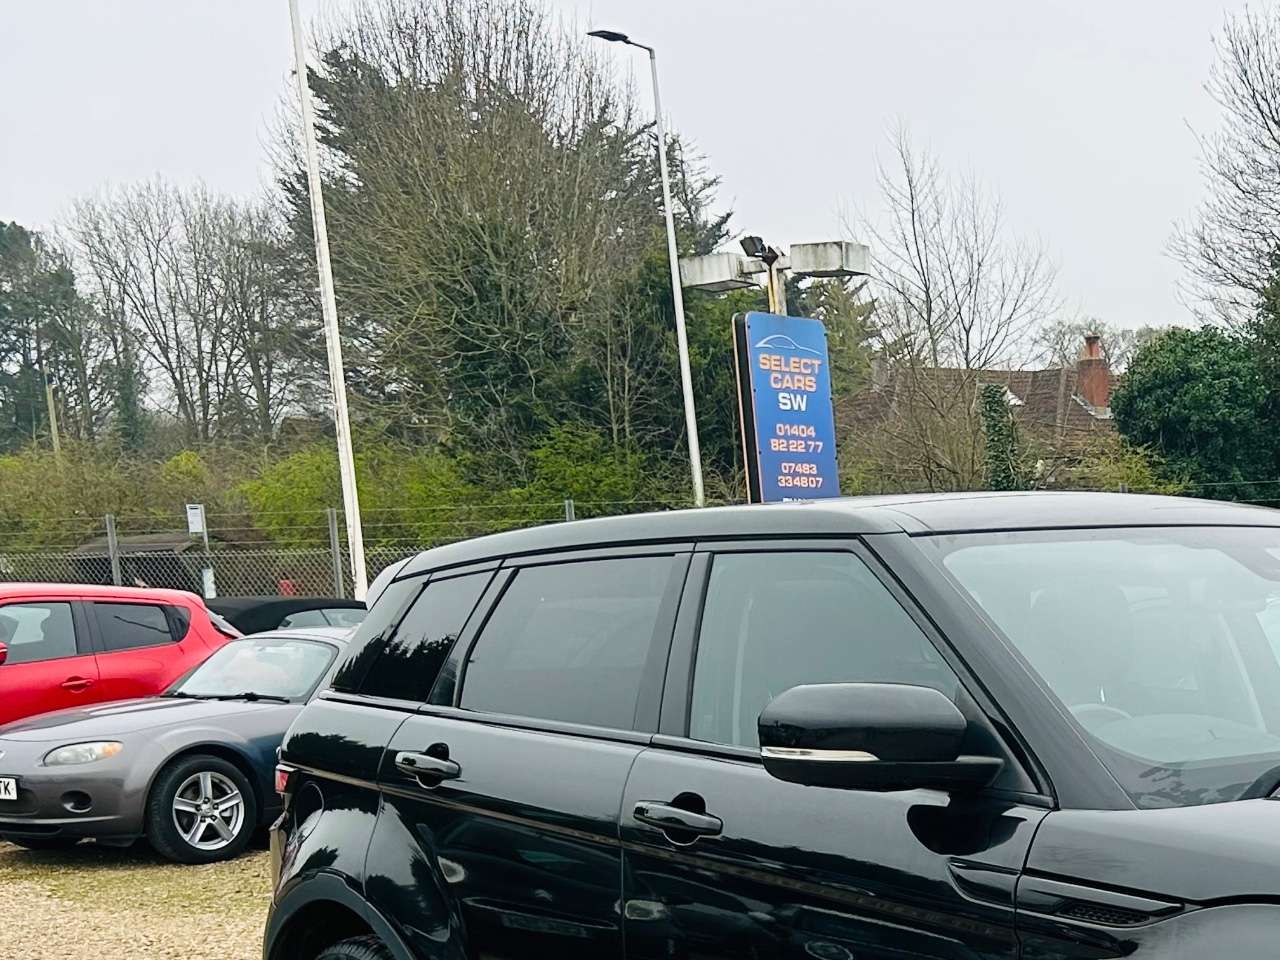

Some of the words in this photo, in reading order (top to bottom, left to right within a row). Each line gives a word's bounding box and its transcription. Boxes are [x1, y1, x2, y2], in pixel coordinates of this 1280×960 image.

[759, 353, 822, 374] SELECT
[770, 373, 817, 392] CARS
[778, 391, 808, 412] SW
[776, 423, 816, 438] 01404
